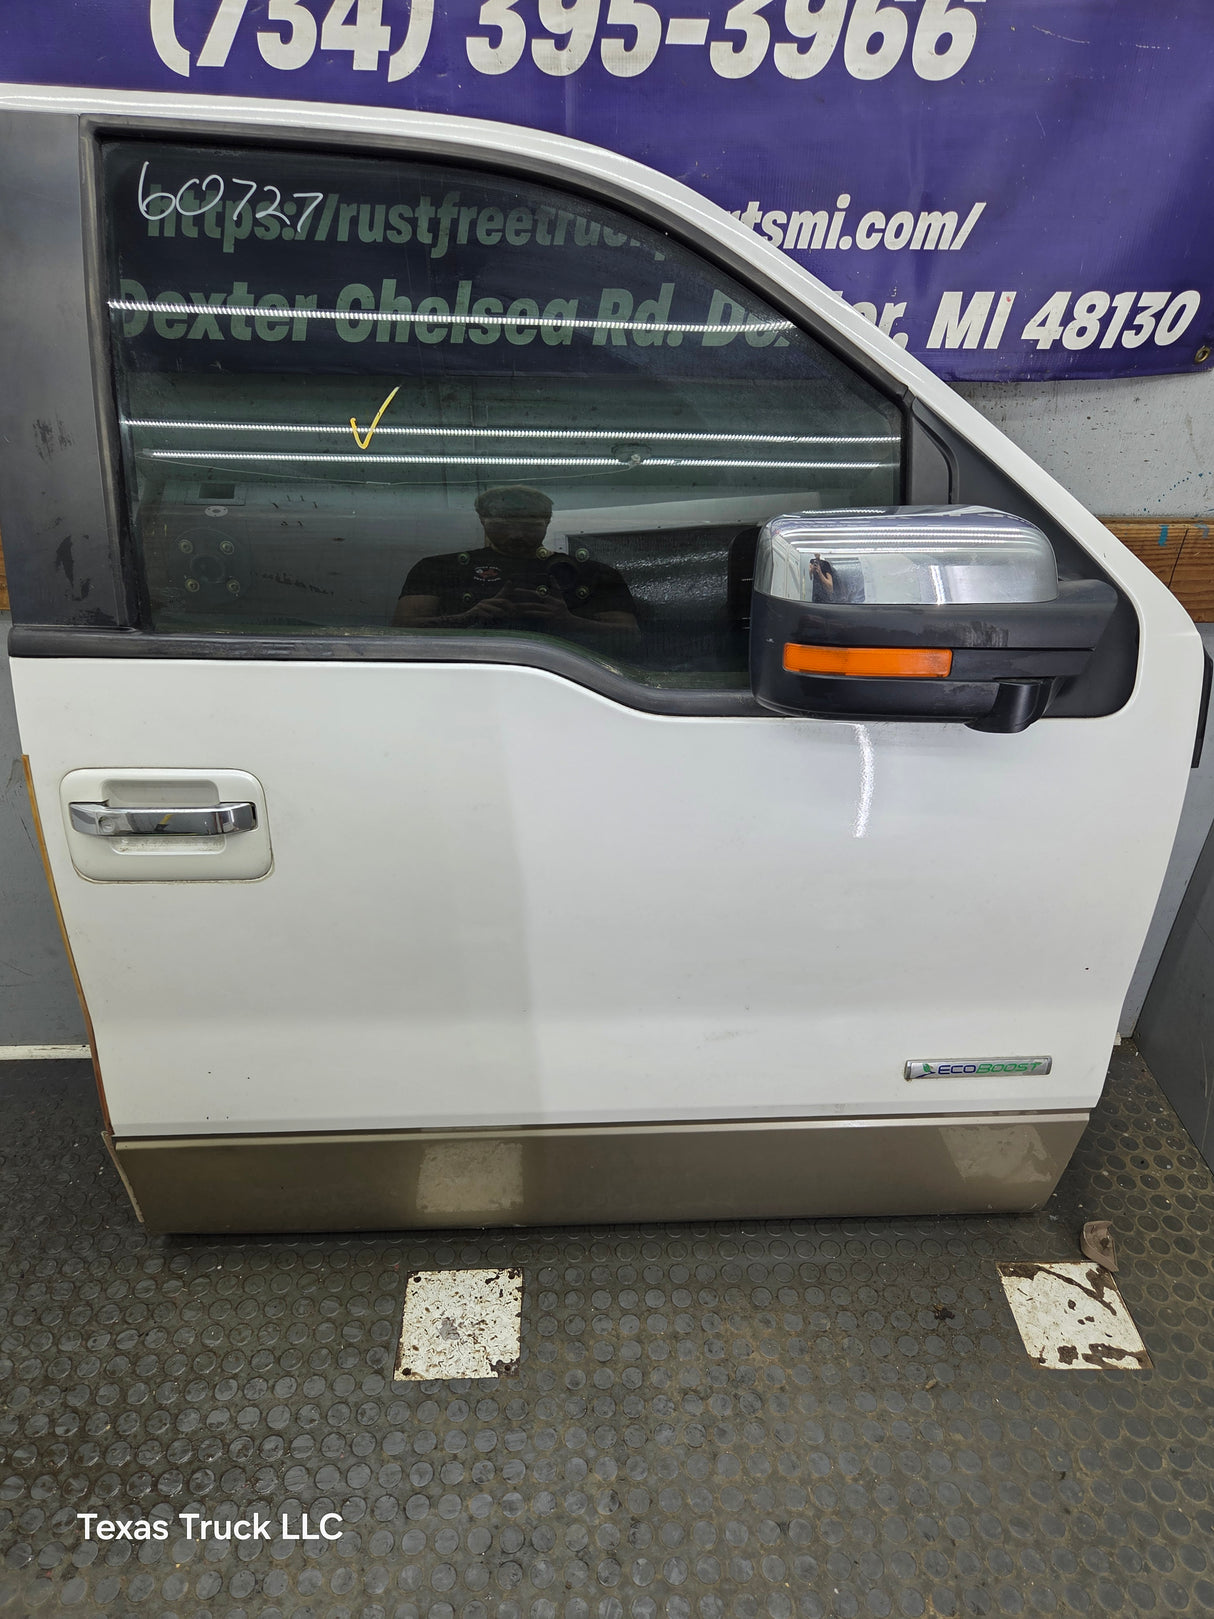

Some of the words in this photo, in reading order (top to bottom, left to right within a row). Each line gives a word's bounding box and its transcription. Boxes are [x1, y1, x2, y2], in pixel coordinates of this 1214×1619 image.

[150, 0, 434, 82] (734)
[466, 0, 985, 81] 395-3966
[138, 161, 323, 232] 60727
[120, 278, 317, 342] Dexter
[335, 278, 579, 345] Chelsea
[592, 283, 684, 346] Rd.
[926, 291, 1016, 349] MI
[1021, 290, 1200, 350] 48130
[937, 1062, 1042, 1075] ECOBOOST
